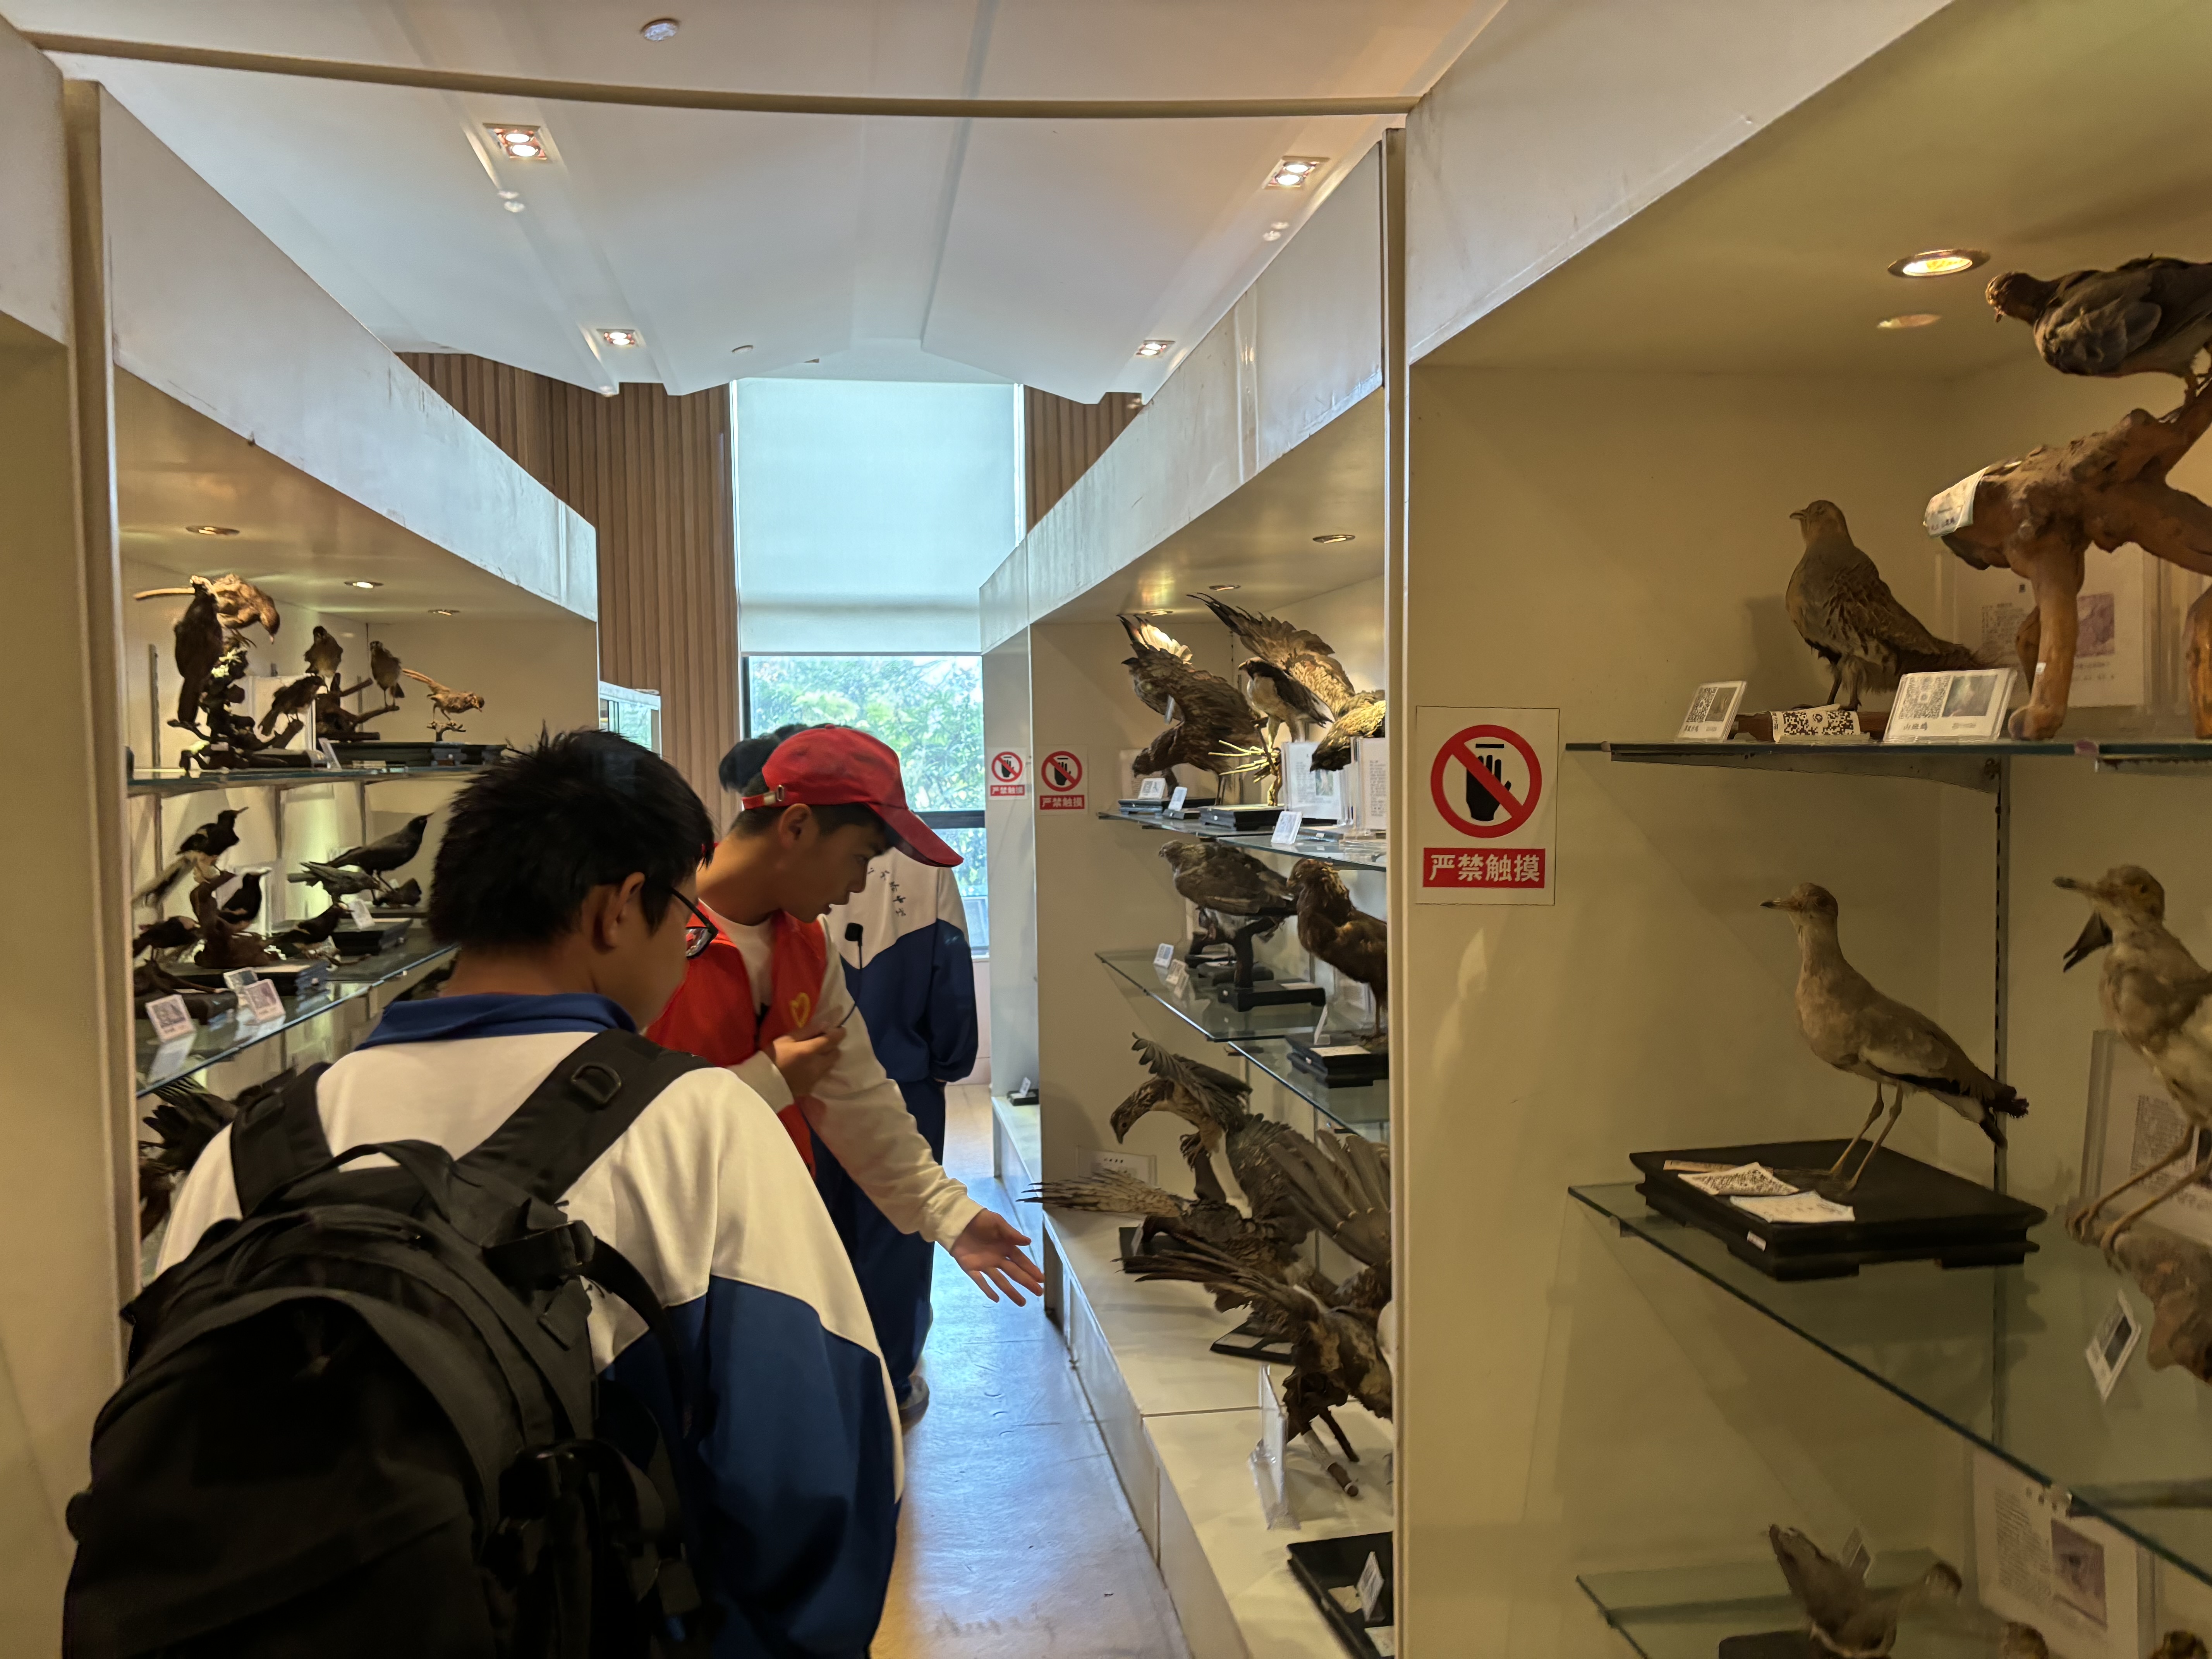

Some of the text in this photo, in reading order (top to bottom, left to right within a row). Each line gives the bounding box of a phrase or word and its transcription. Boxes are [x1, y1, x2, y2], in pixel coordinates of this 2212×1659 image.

[1042, 797, 1082, 807] 严禁触摸
[1429, 854, 1540, 882] 严禁触摸
